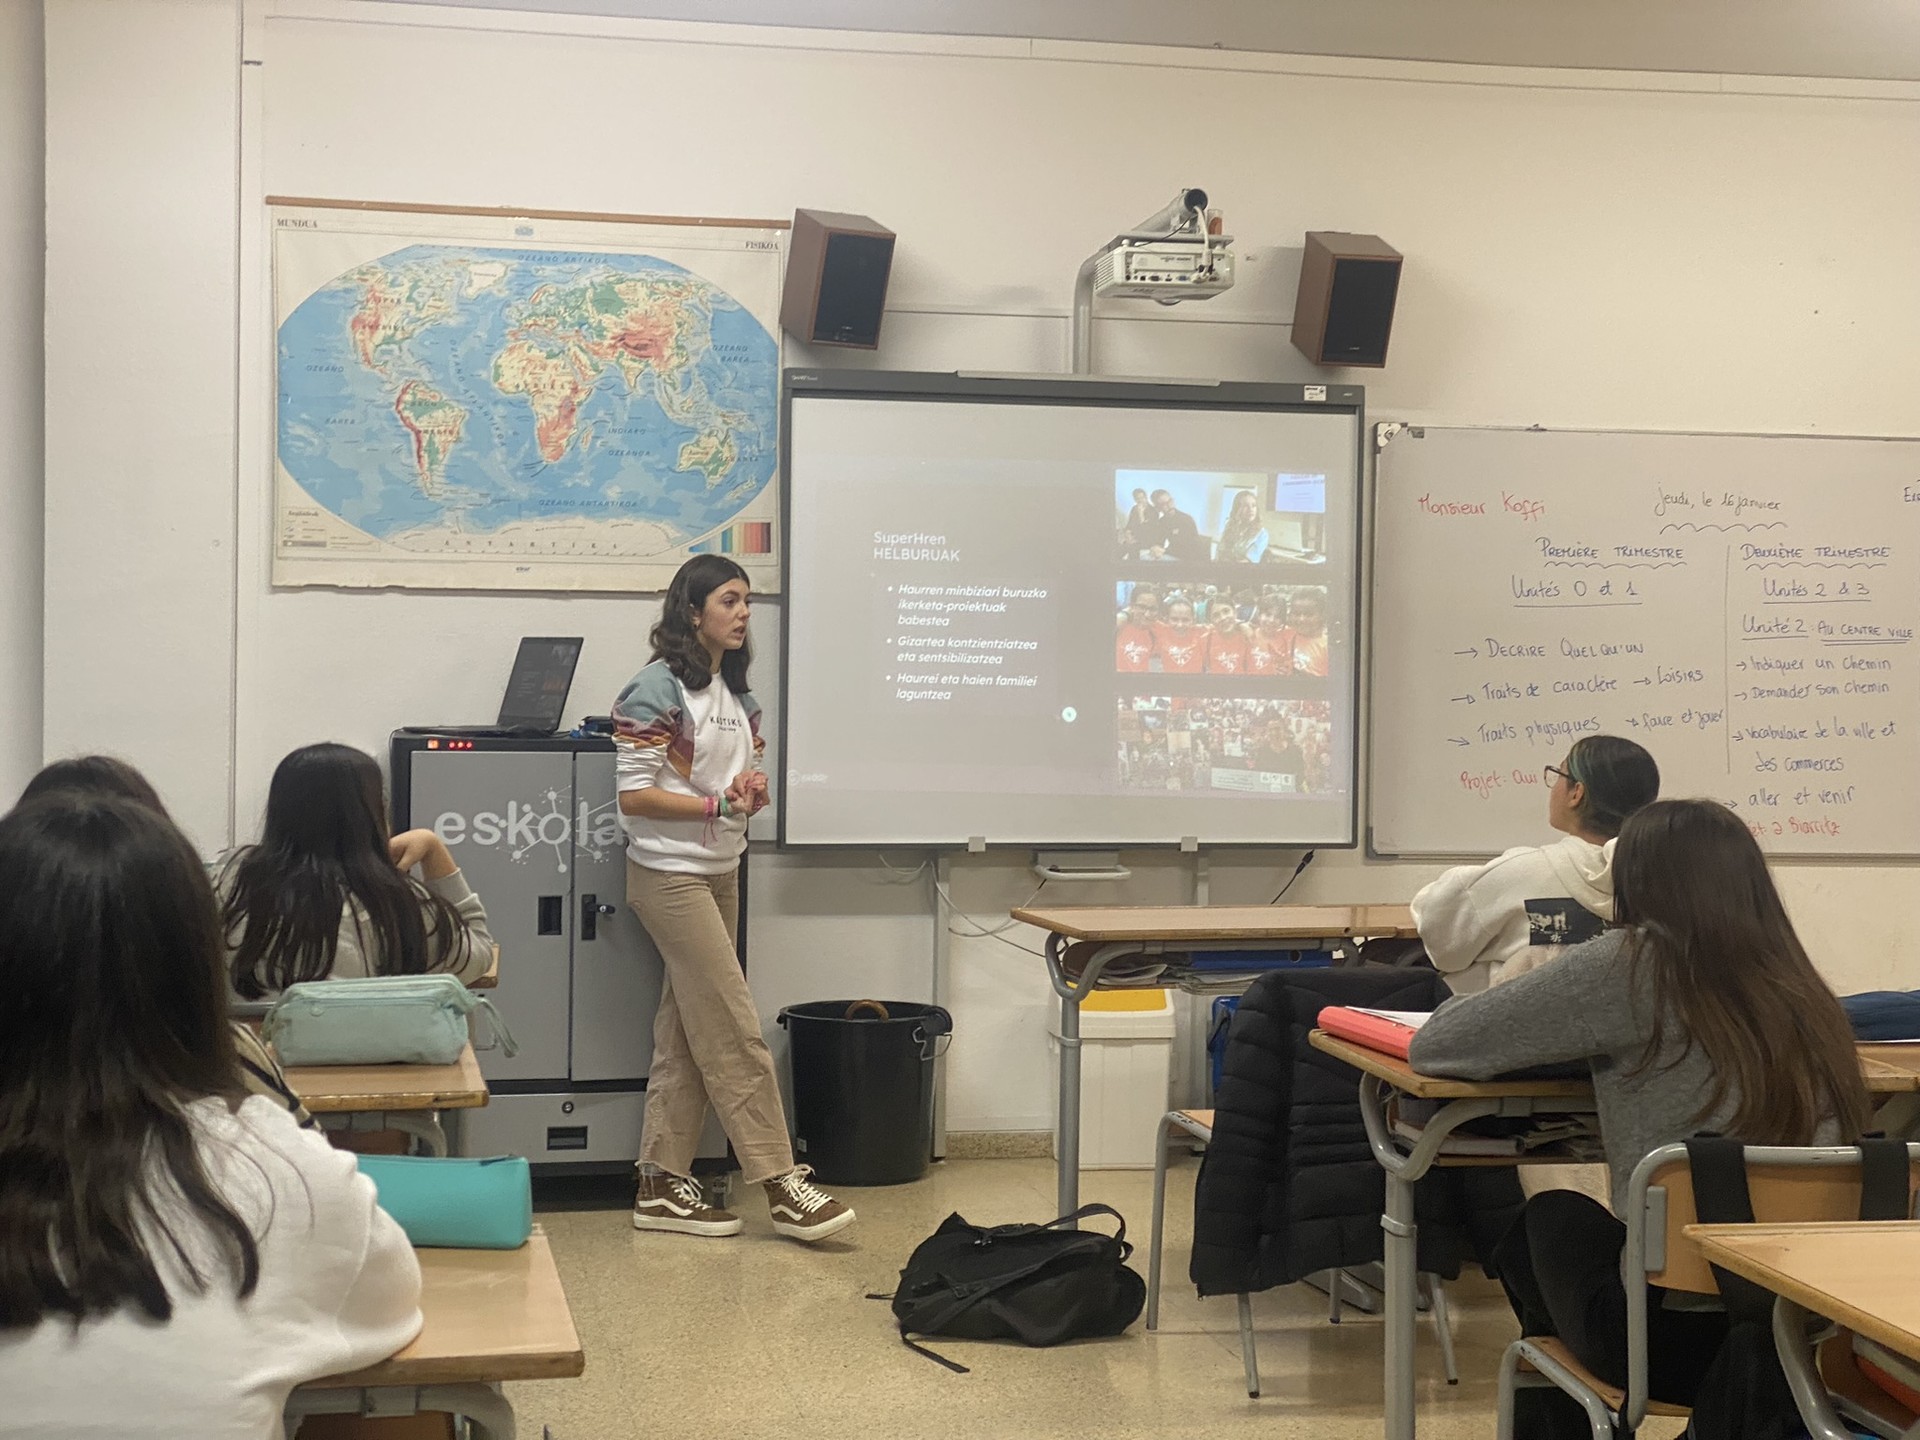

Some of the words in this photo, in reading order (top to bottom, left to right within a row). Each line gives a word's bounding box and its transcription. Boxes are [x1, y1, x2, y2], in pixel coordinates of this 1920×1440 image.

[1418, 493, 1486, 516] Monsieur
[1702, 491, 1713, 507] le
[873, 531, 946, 545] SuperHren
[873, 547, 961, 562] HELBURUAK
[898, 584, 943, 596] Haurren
[945, 585, 1000, 597] minbiziari
[1002, 586, 1048, 599] buruzko
[1599, 580, 1613, 596] et
[1814, 583, 1828, 597] 2
[1857, 583, 1871, 595] 3
[897, 614, 950, 626] babestea
[897, 635, 945, 648] Gizartea
[947, 636, 1038, 650] kontzientziatzea
[896, 652, 916, 662] eta
[918, 652, 1003, 665] sentsibilizatzea
[896, 672, 938, 684] Haurrei
[940, 674, 959, 685] eta
[961, 674, 993, 686] haien
[995, 674, 1038, 687] familiei
[895, 688, 951, 702] laguntzea
[434, 800, 625, 847] eskola
